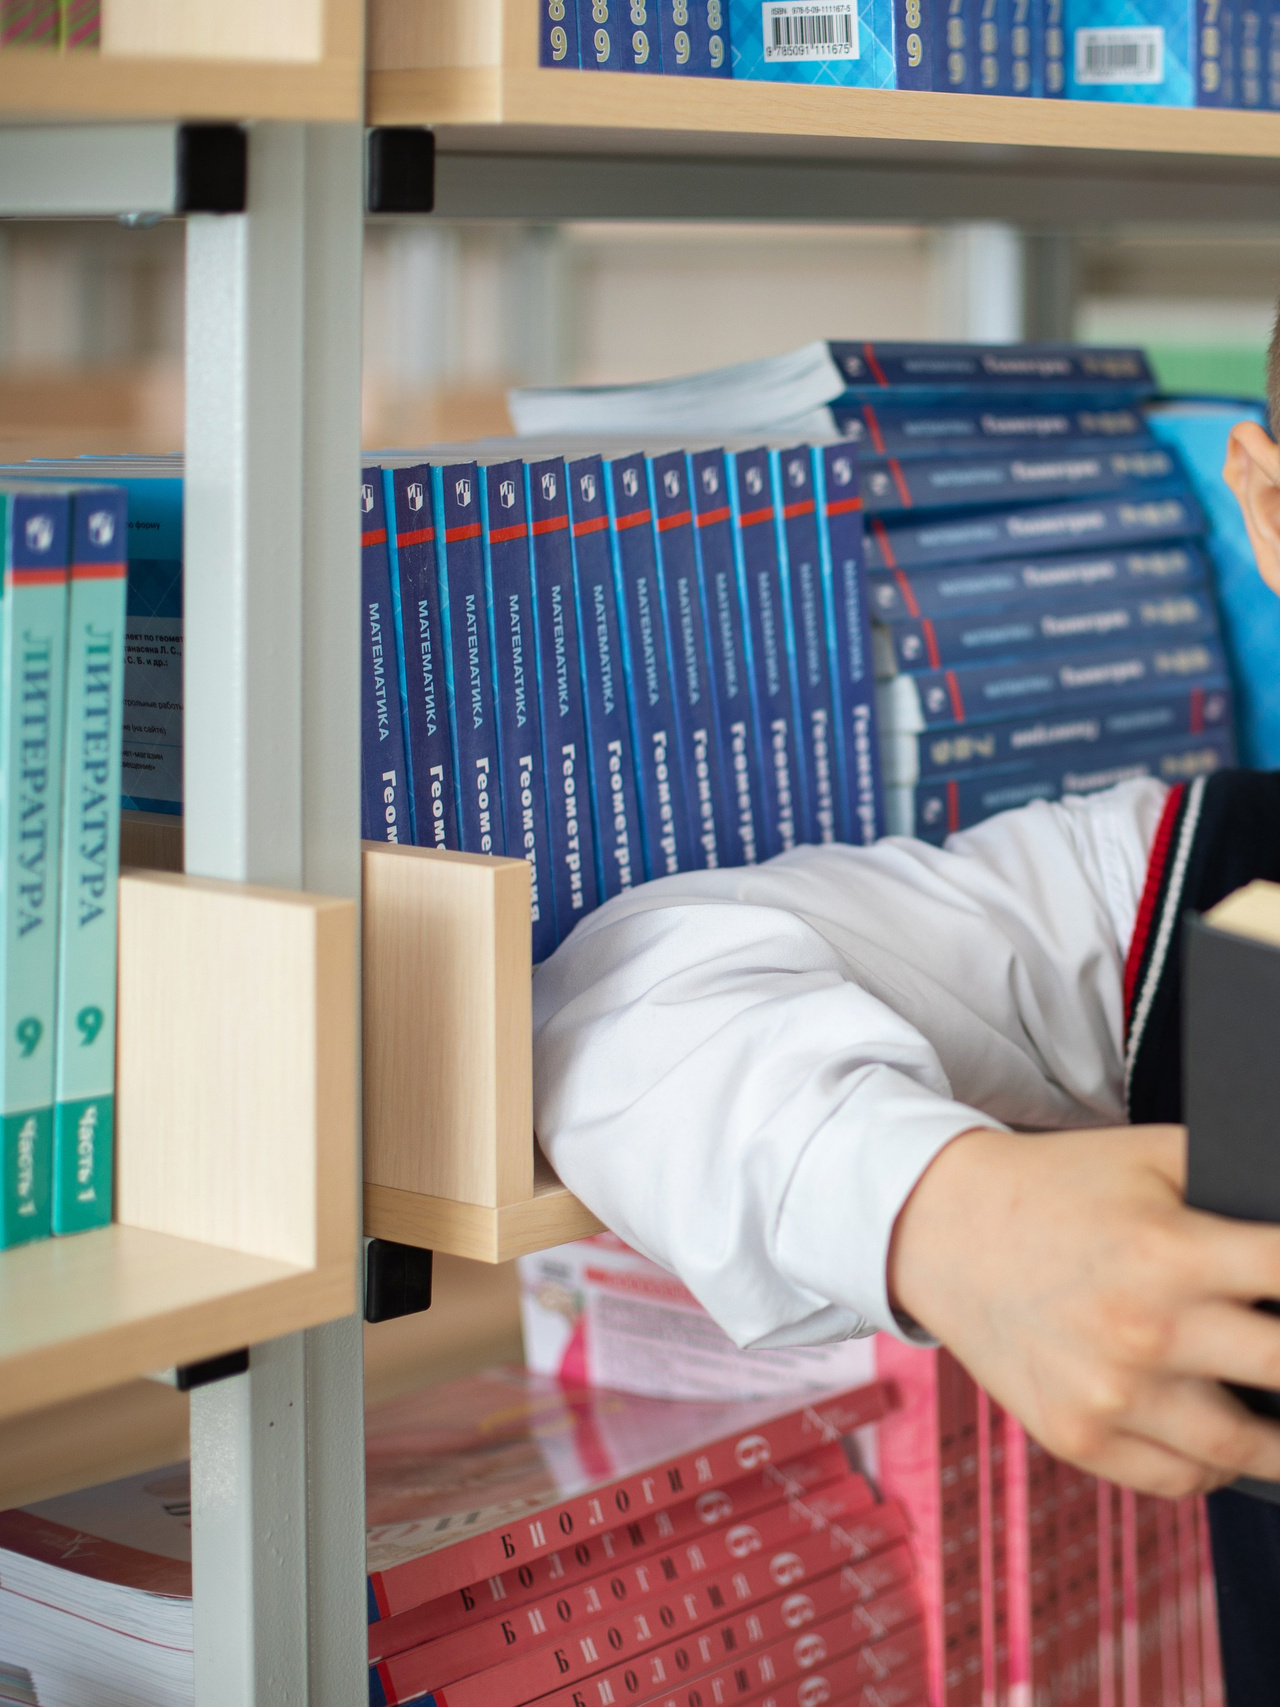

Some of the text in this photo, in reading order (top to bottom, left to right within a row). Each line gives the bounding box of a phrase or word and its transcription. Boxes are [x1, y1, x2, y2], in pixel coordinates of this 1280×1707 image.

[550, 26, 567, 61] 9
[594, 28, 610, 62] 9
[632, 30, 649, 64] 9
[674, 30, 690, 64] 9
[708, 35, 725, 69] 9
[906, 33, 922, 67] 9
[369, 602, 390, 742] МАТЕМАТИКА
[418, 599, 437, 737] МАТЕМАТИКА
[465, 594, 484, 730] МАТЕМАТИКА
[509, 594, 527, 728] МАТЕМАТИКА
[551, 585, 570, 718] МАТЕМАТИКА
[593, 584, 615, 715] МАТЕМАТИКА
[636, 577, 660, 707] МАТЕМАТИКА
[18, 627, 50, 937] ЛИТЕРАТУРА
[79, 623, 112, 928] ЛИТЕРАТУРА
[476, 757, 492, 856] Геоме
[562, 743, 583, 910] Геометрия
[15, 1016, 43, 1058] 9
[75, 1005, 104, 1046] 9
[500, 1456, 712, 1559] БИОЛОГИЯ
